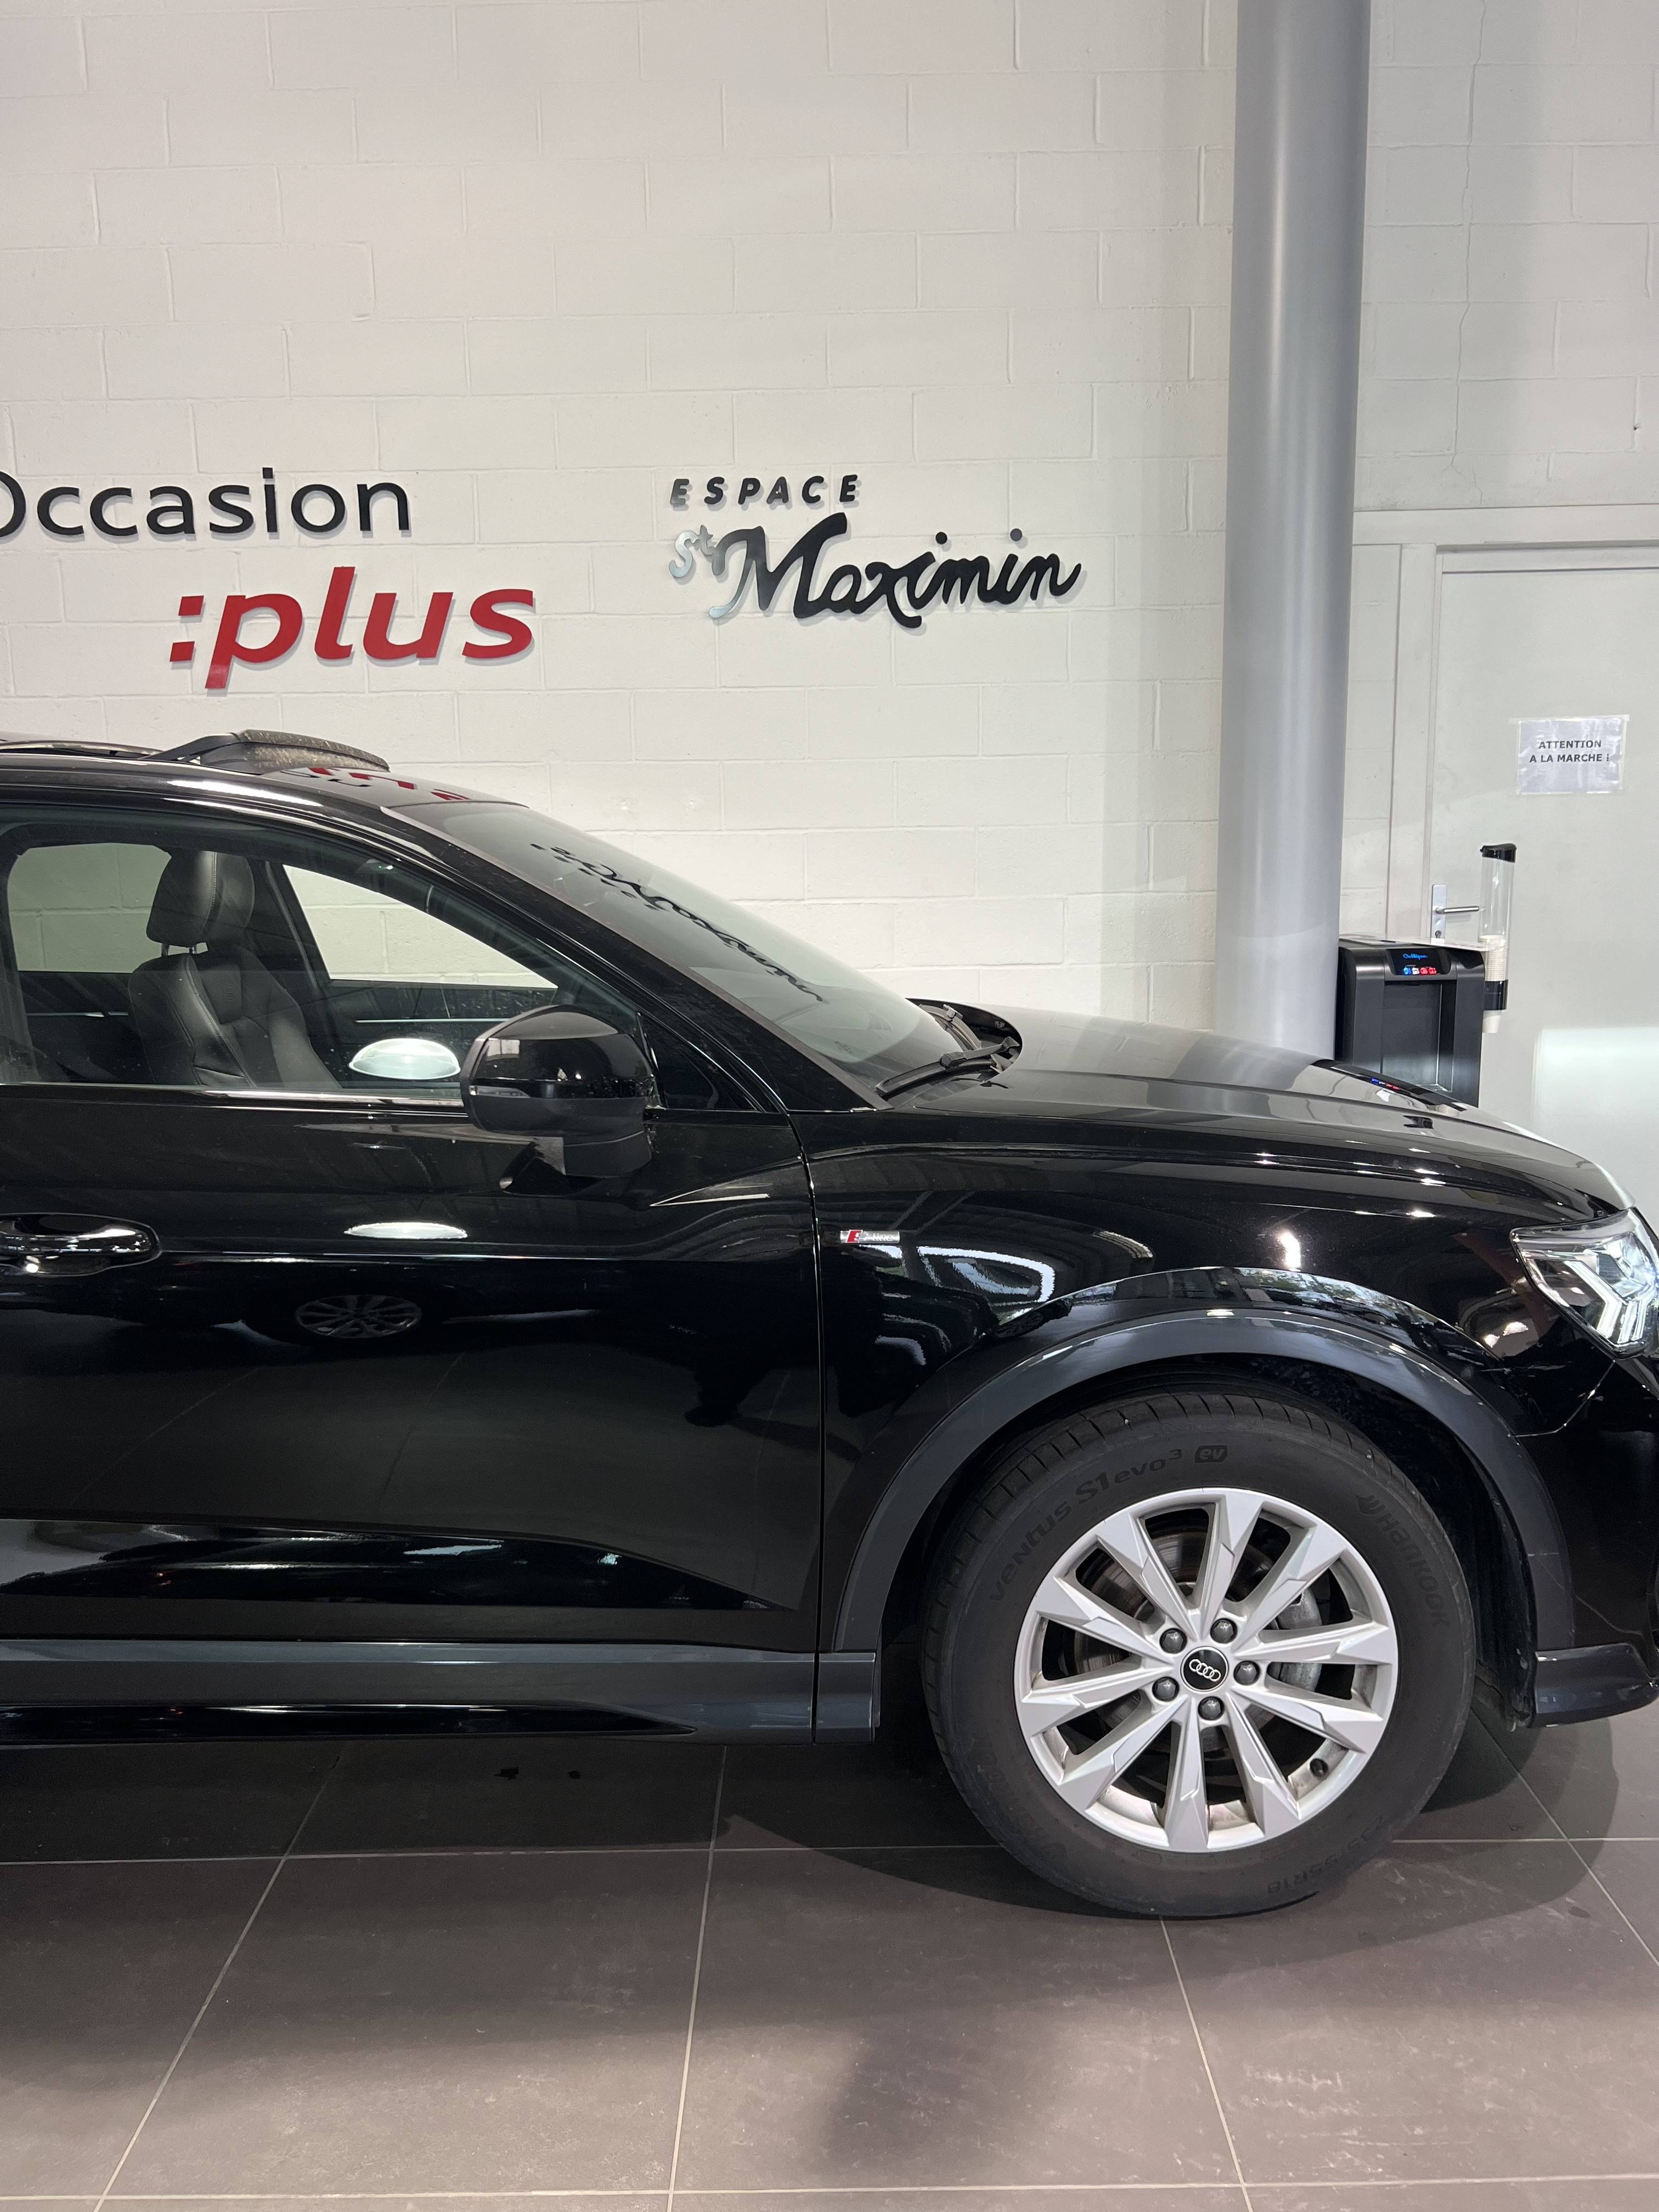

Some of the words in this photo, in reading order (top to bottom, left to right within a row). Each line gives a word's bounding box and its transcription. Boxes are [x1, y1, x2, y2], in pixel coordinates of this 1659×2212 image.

[670, 475, 858, 506] ESPACE
[709, 512, 1082, 629] Maximin
[1539, 740, 1601, 749] ATTENTION
[1529, 755, 1537, 763] A
[1557, 754, 1602, 762] MARCHE
